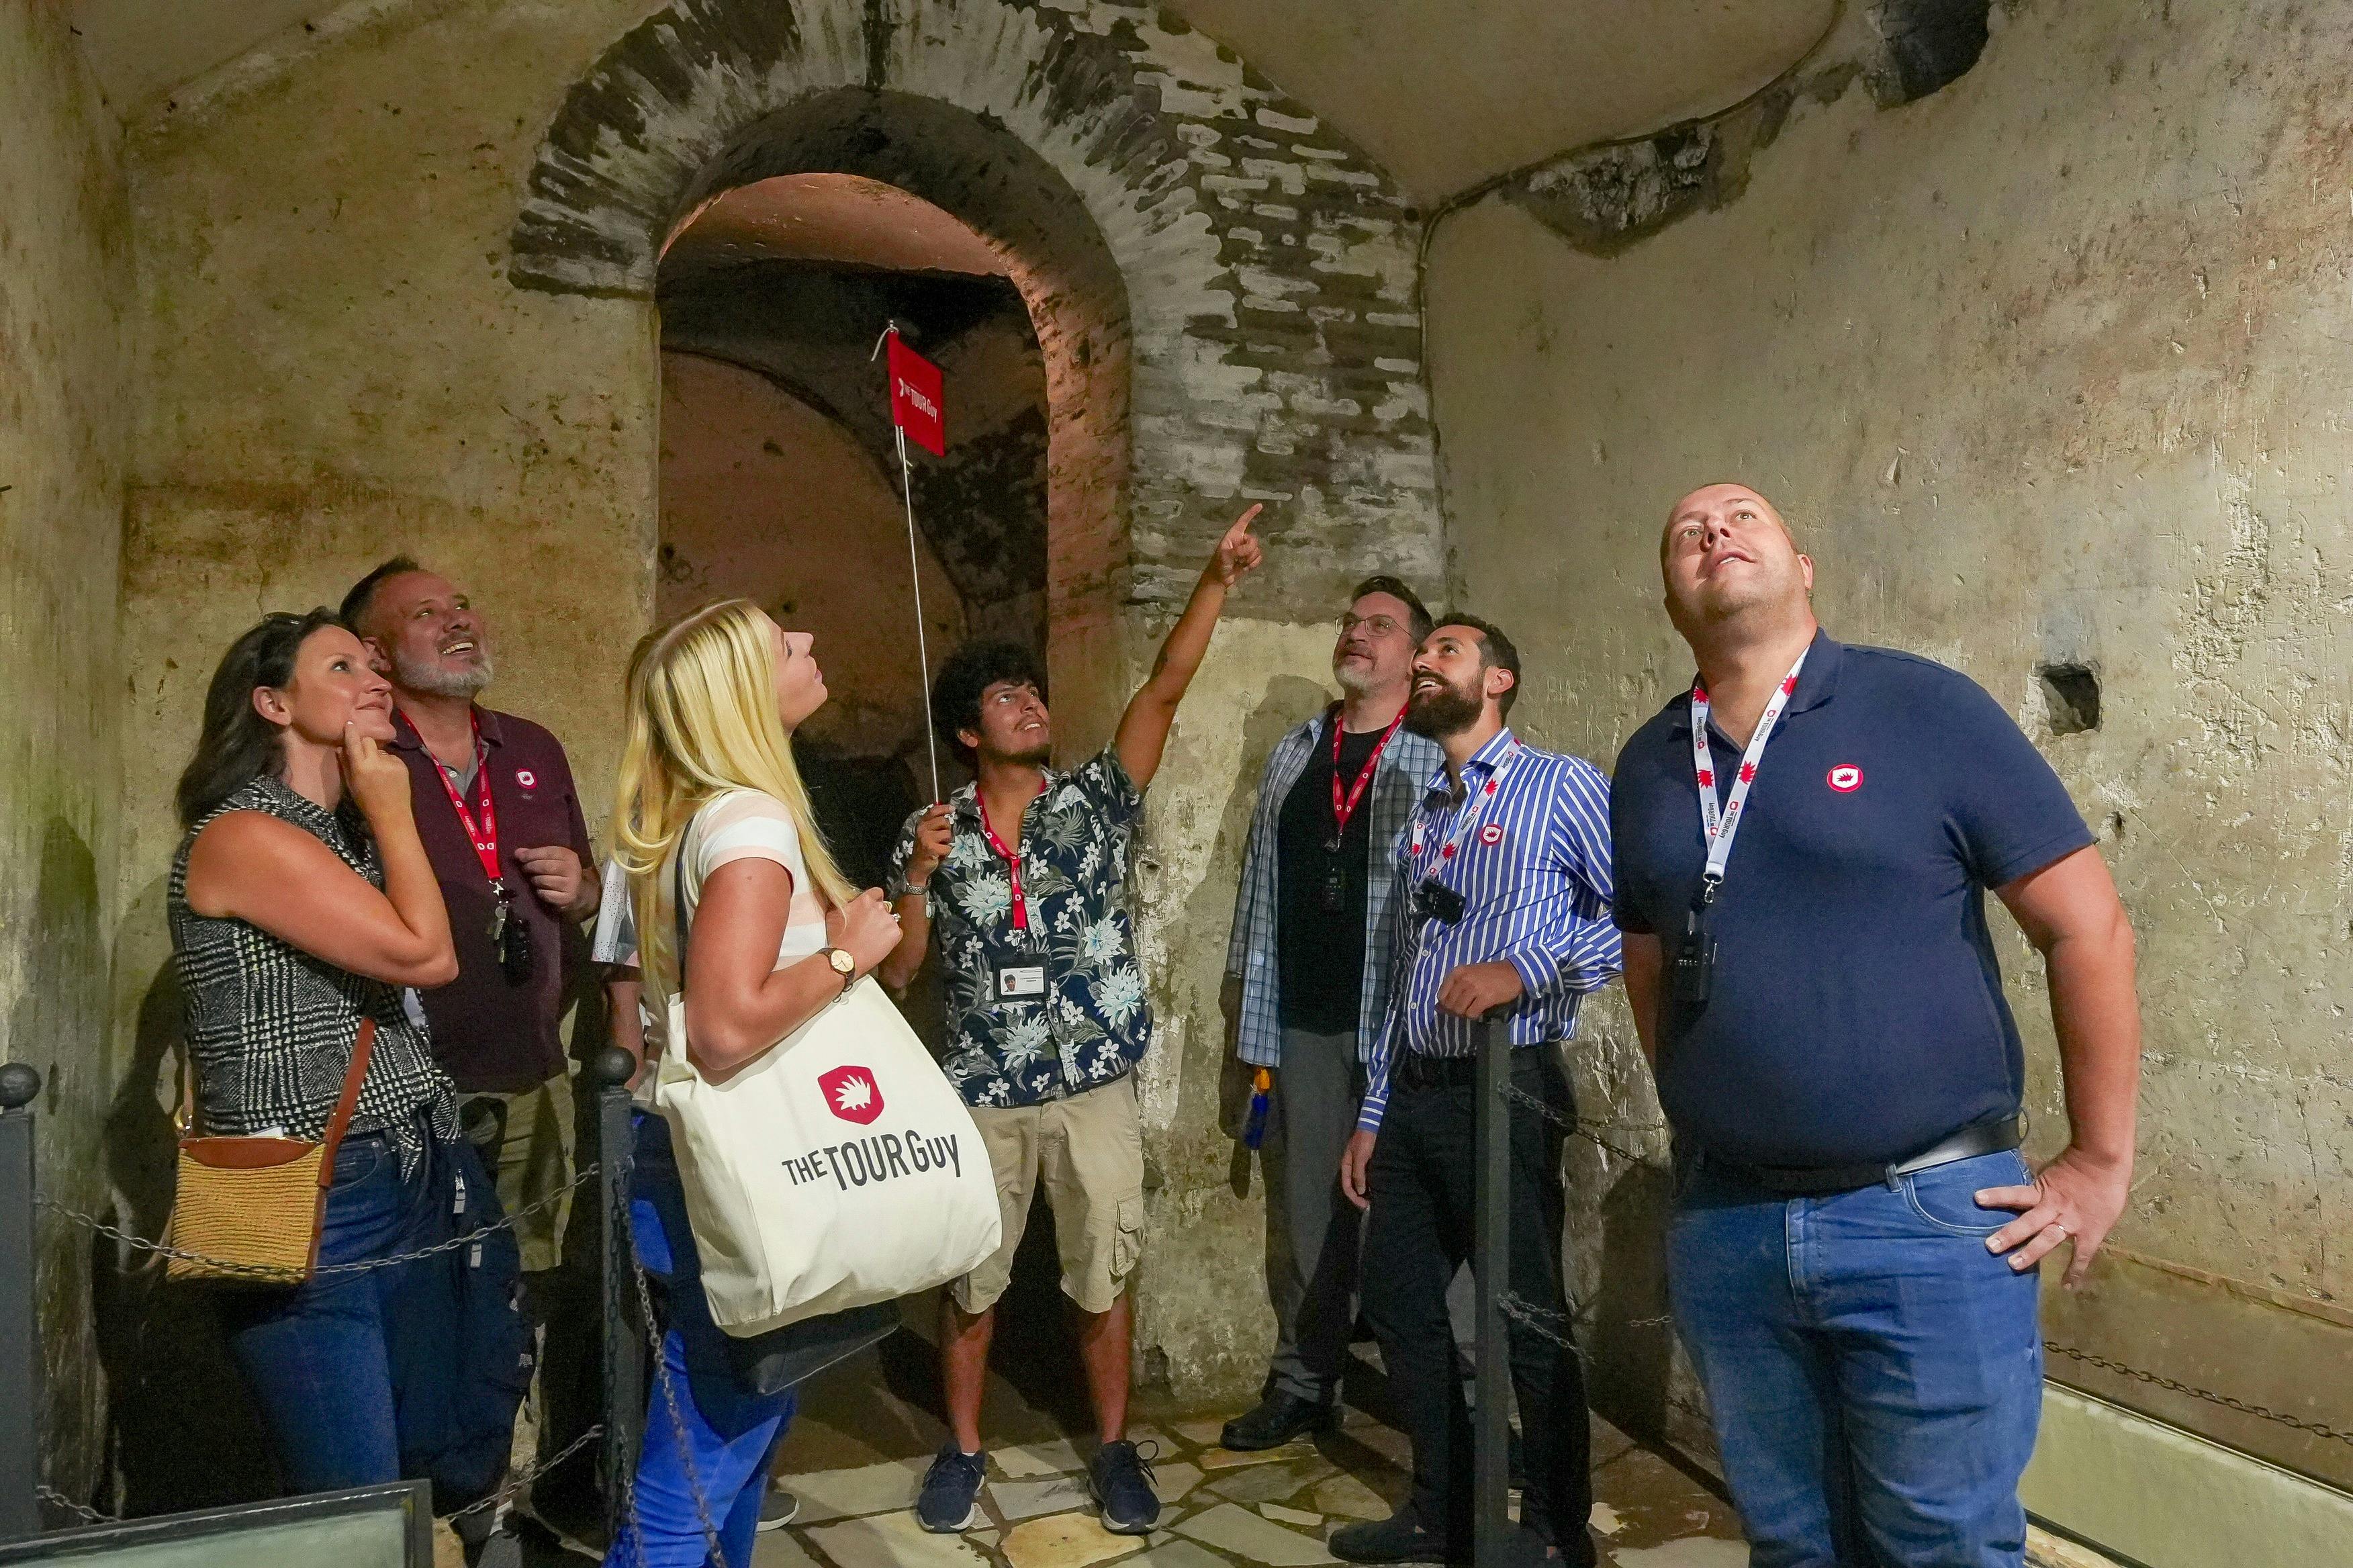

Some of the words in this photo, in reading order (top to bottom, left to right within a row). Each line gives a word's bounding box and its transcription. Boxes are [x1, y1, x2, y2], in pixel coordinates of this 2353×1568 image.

[911, 388, 927, 413] TOUR
[1708, 811, 1716, 822] TOUR
[1723, 816, 1733, 829] TOUR
[781, 1150, 828, 1186] THE
[823, 1133, 911, 1191] TOUR
